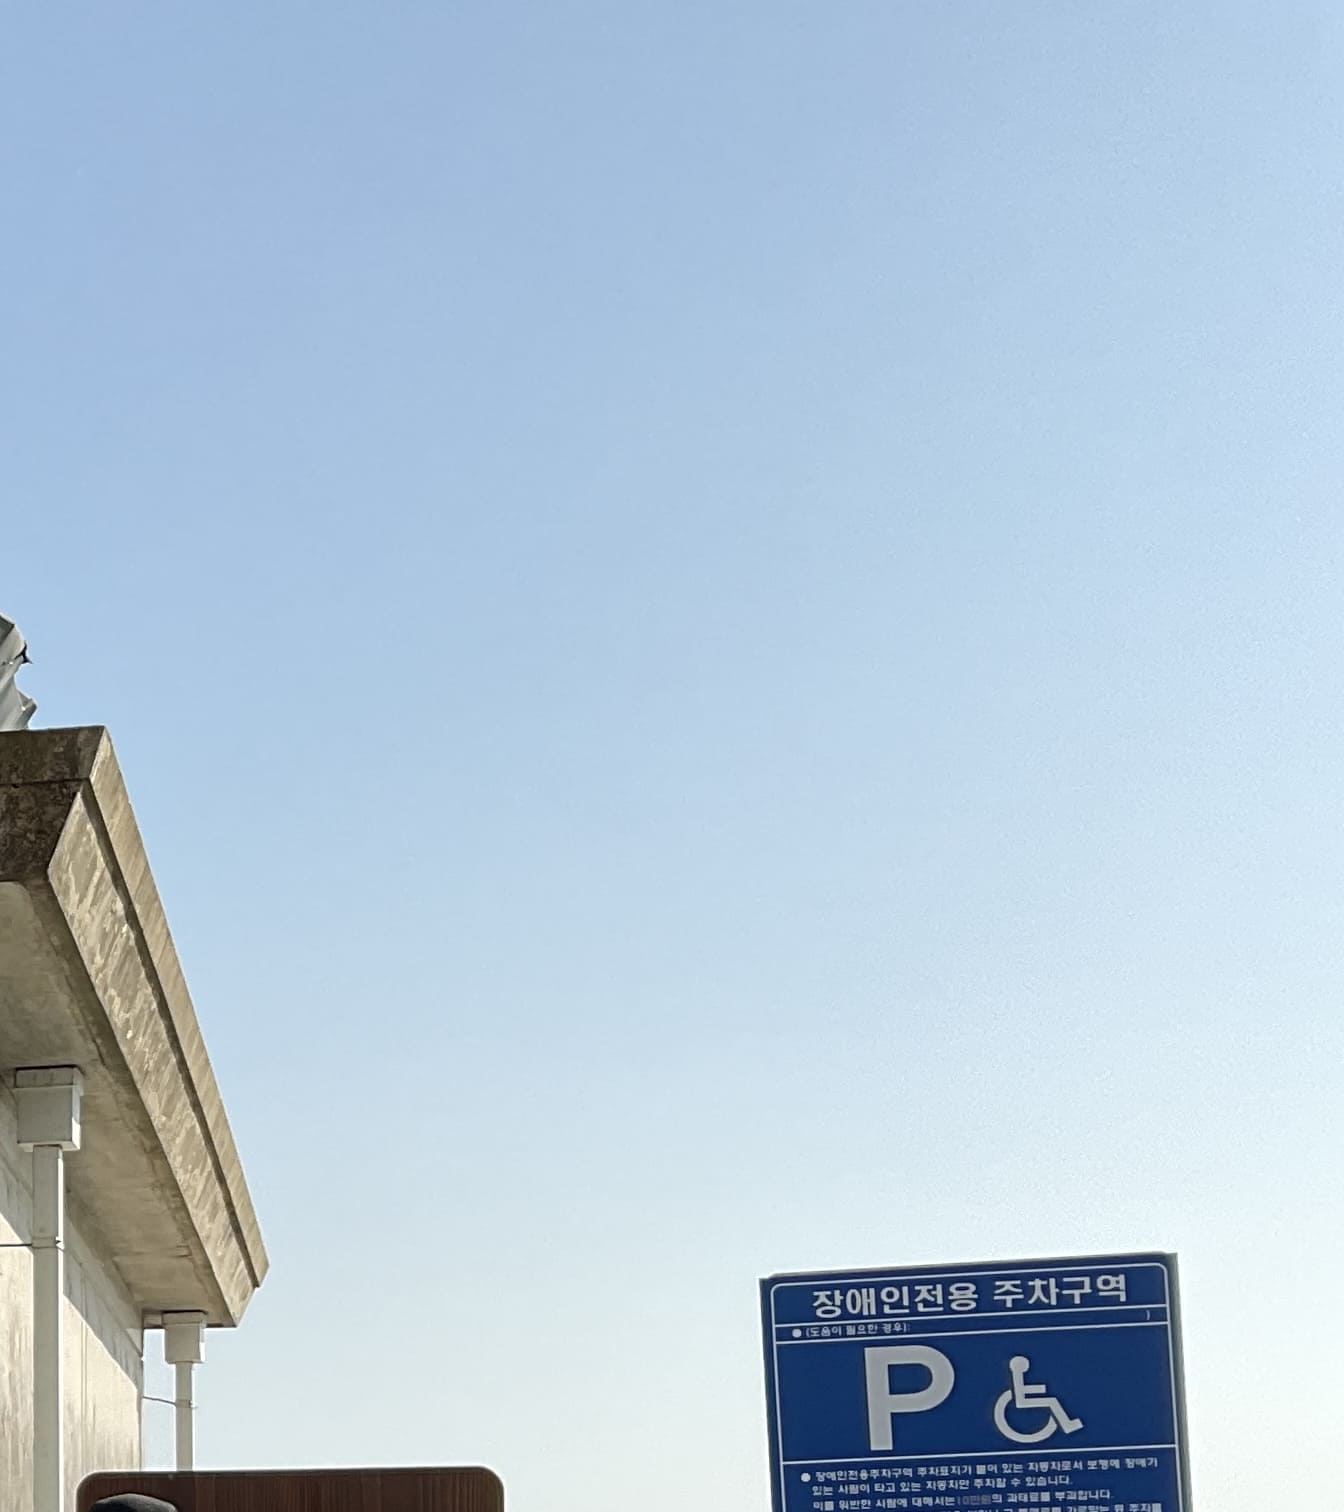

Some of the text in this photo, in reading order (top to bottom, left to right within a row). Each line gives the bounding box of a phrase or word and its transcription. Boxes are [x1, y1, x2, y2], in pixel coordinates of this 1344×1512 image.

[812, 1274, 1127, 1318] 장애인전용 주차구역
[864, 1345, 955, 1451] P
